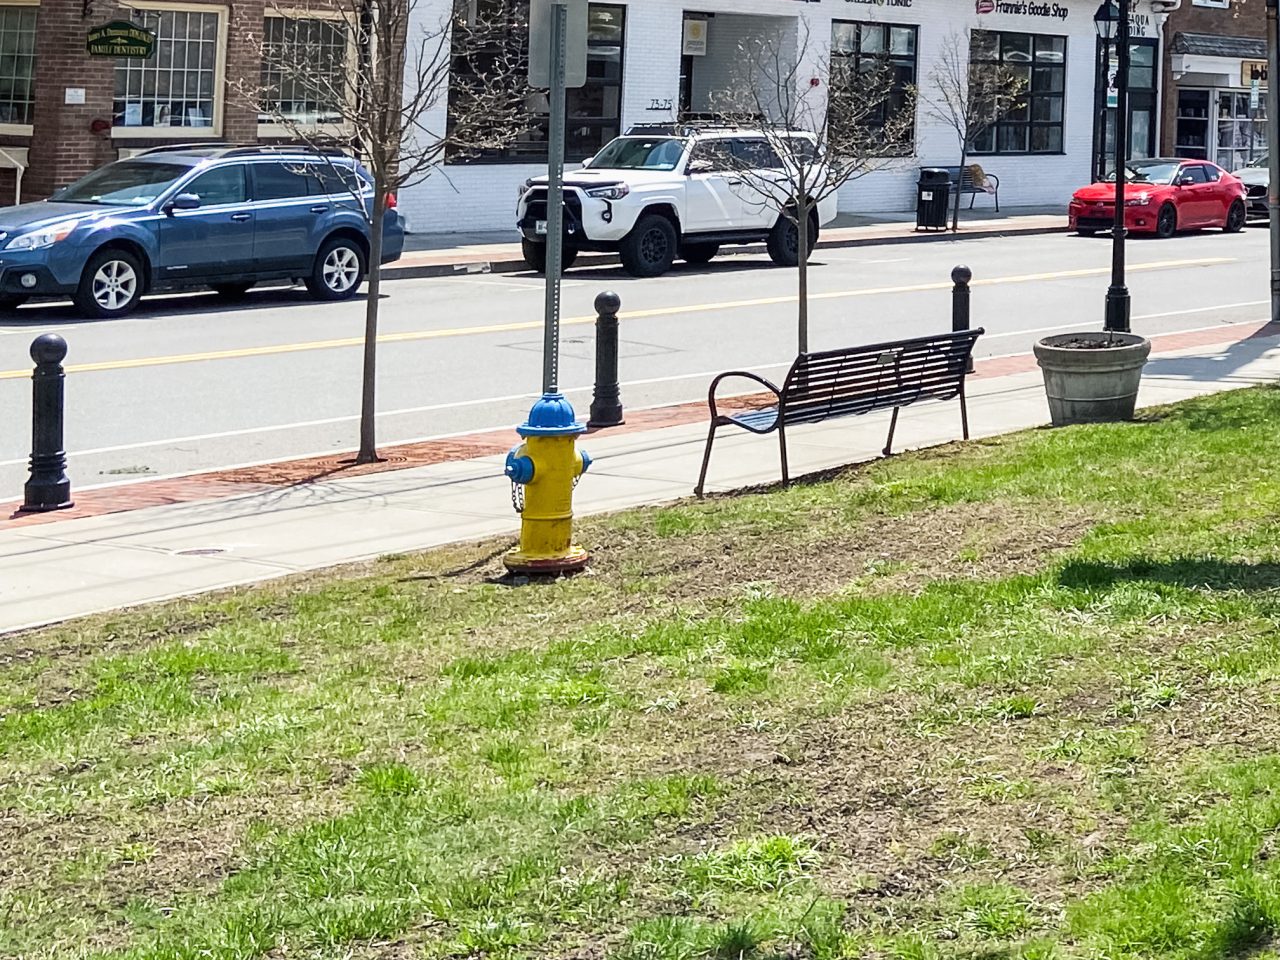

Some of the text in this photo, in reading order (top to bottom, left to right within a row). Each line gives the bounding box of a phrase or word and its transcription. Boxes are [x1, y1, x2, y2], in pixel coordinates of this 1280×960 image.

[1028, 1, 1051, 17] Goodie
[1051, 3, 1069, 21] Shop
[113, 45, 147, 55] DENTISTRY
